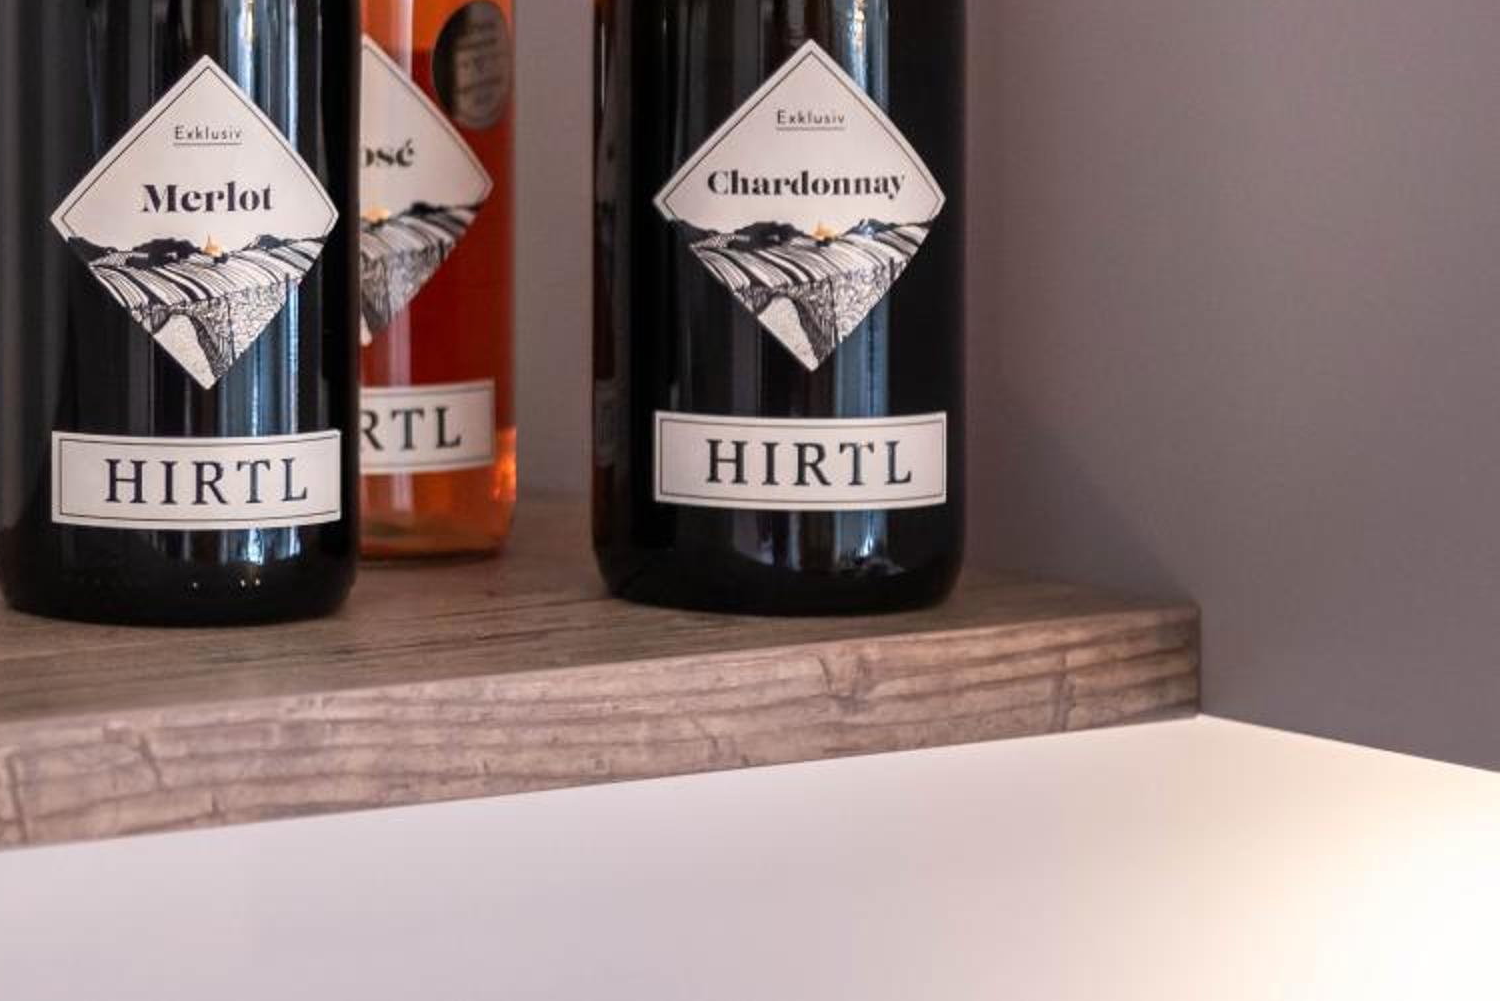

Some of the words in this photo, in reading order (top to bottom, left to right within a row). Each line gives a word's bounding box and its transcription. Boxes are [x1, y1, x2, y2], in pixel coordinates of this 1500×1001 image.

[173, 125, 243, 142] Exklusiv
[776, 109, 846, 125] Exklusiv
[140, 181, 274, 215] Merlot
[706, 170, 905, 200] Chardonnay
[360, 406, 463, 452] RTL
[706, 439, 913, 485] HIRTL
[104, 458, 308, 505] HIRTL
